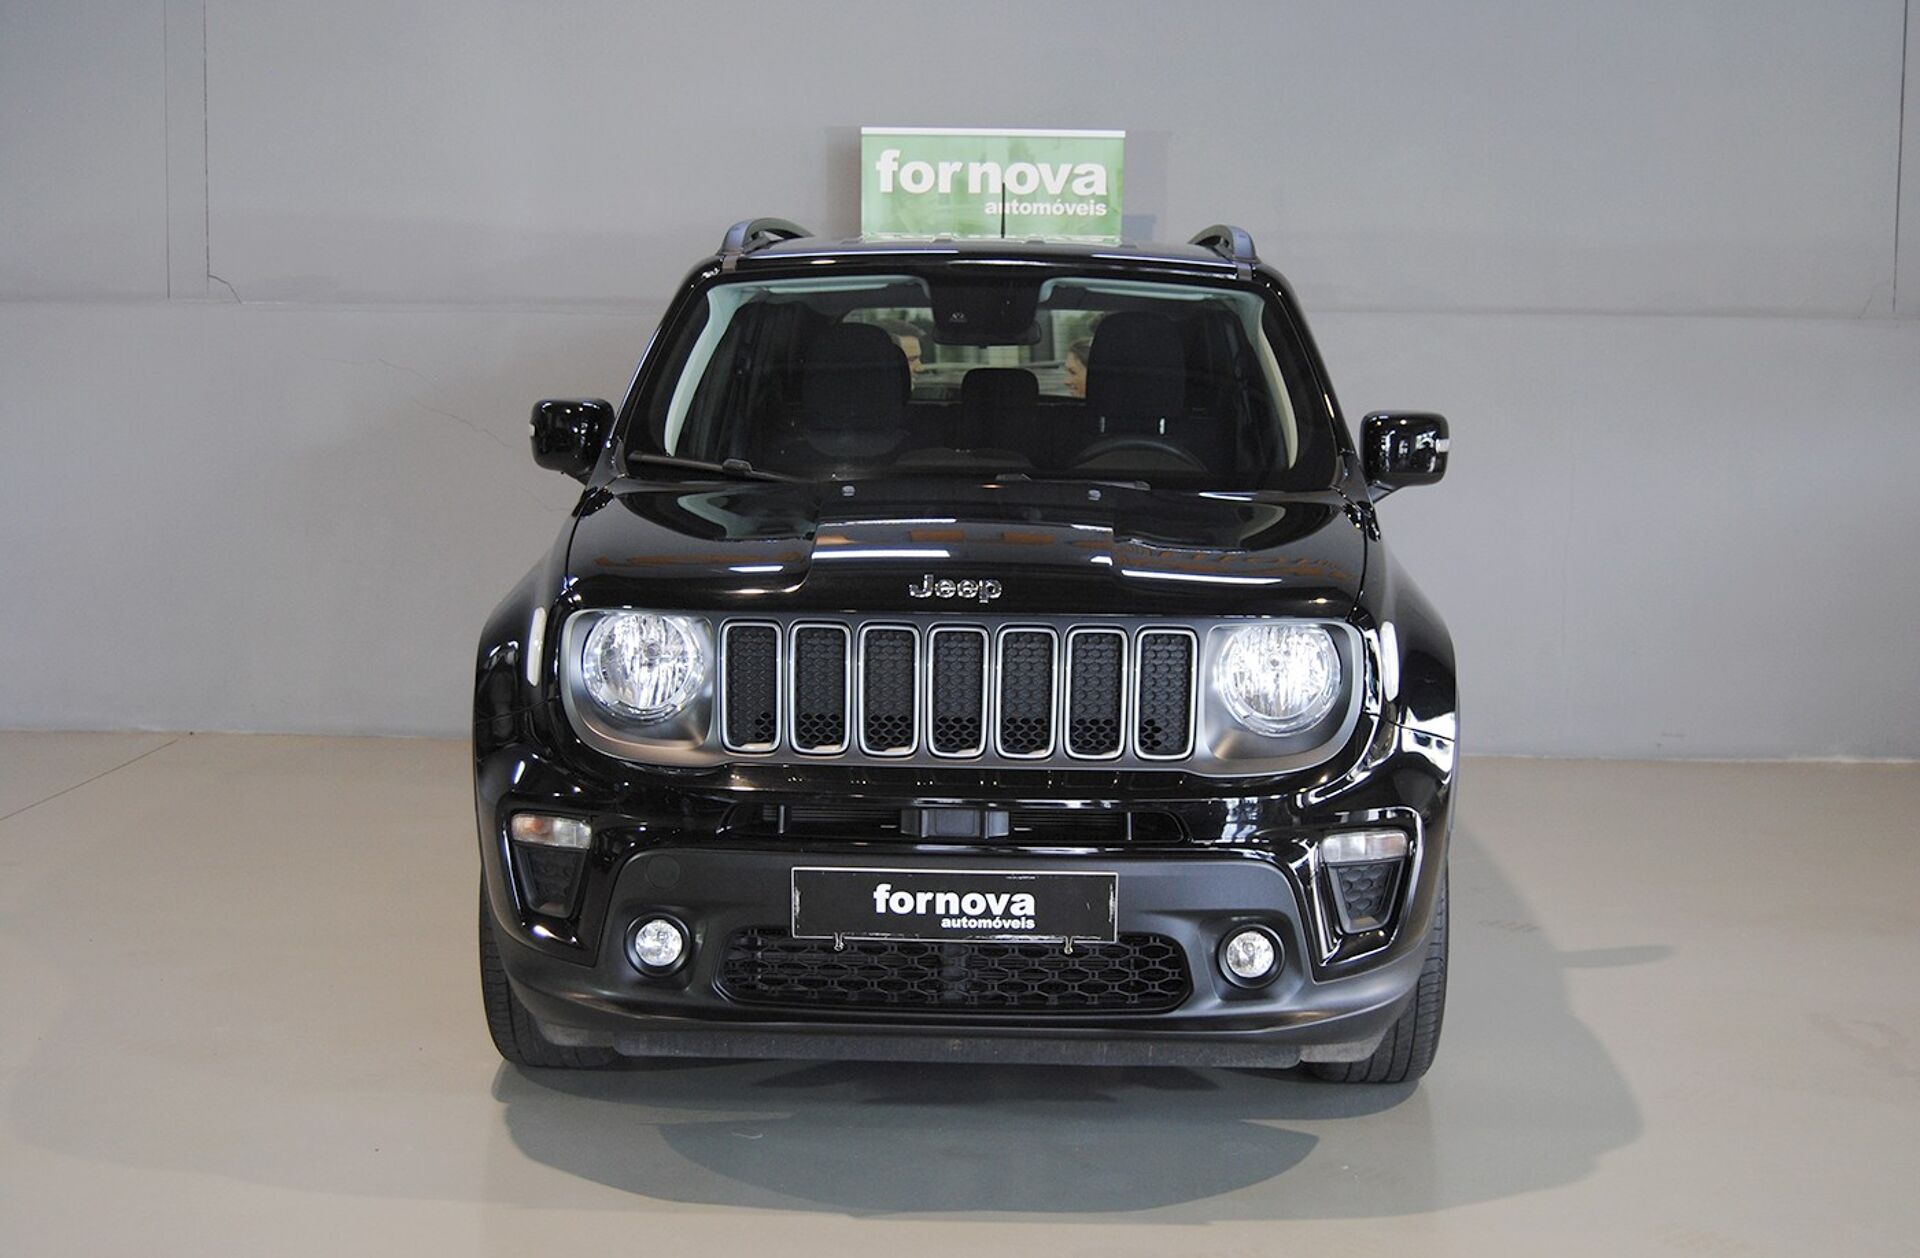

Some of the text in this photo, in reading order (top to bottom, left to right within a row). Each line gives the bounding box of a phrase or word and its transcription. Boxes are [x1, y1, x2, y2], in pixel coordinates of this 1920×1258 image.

[876, 149, 1107, 195] fornova
[909, 574, 1002, 603] Jeep
[873, 884, 1035, 916] fornova
[941, 916, 1035, 930] automóveis
